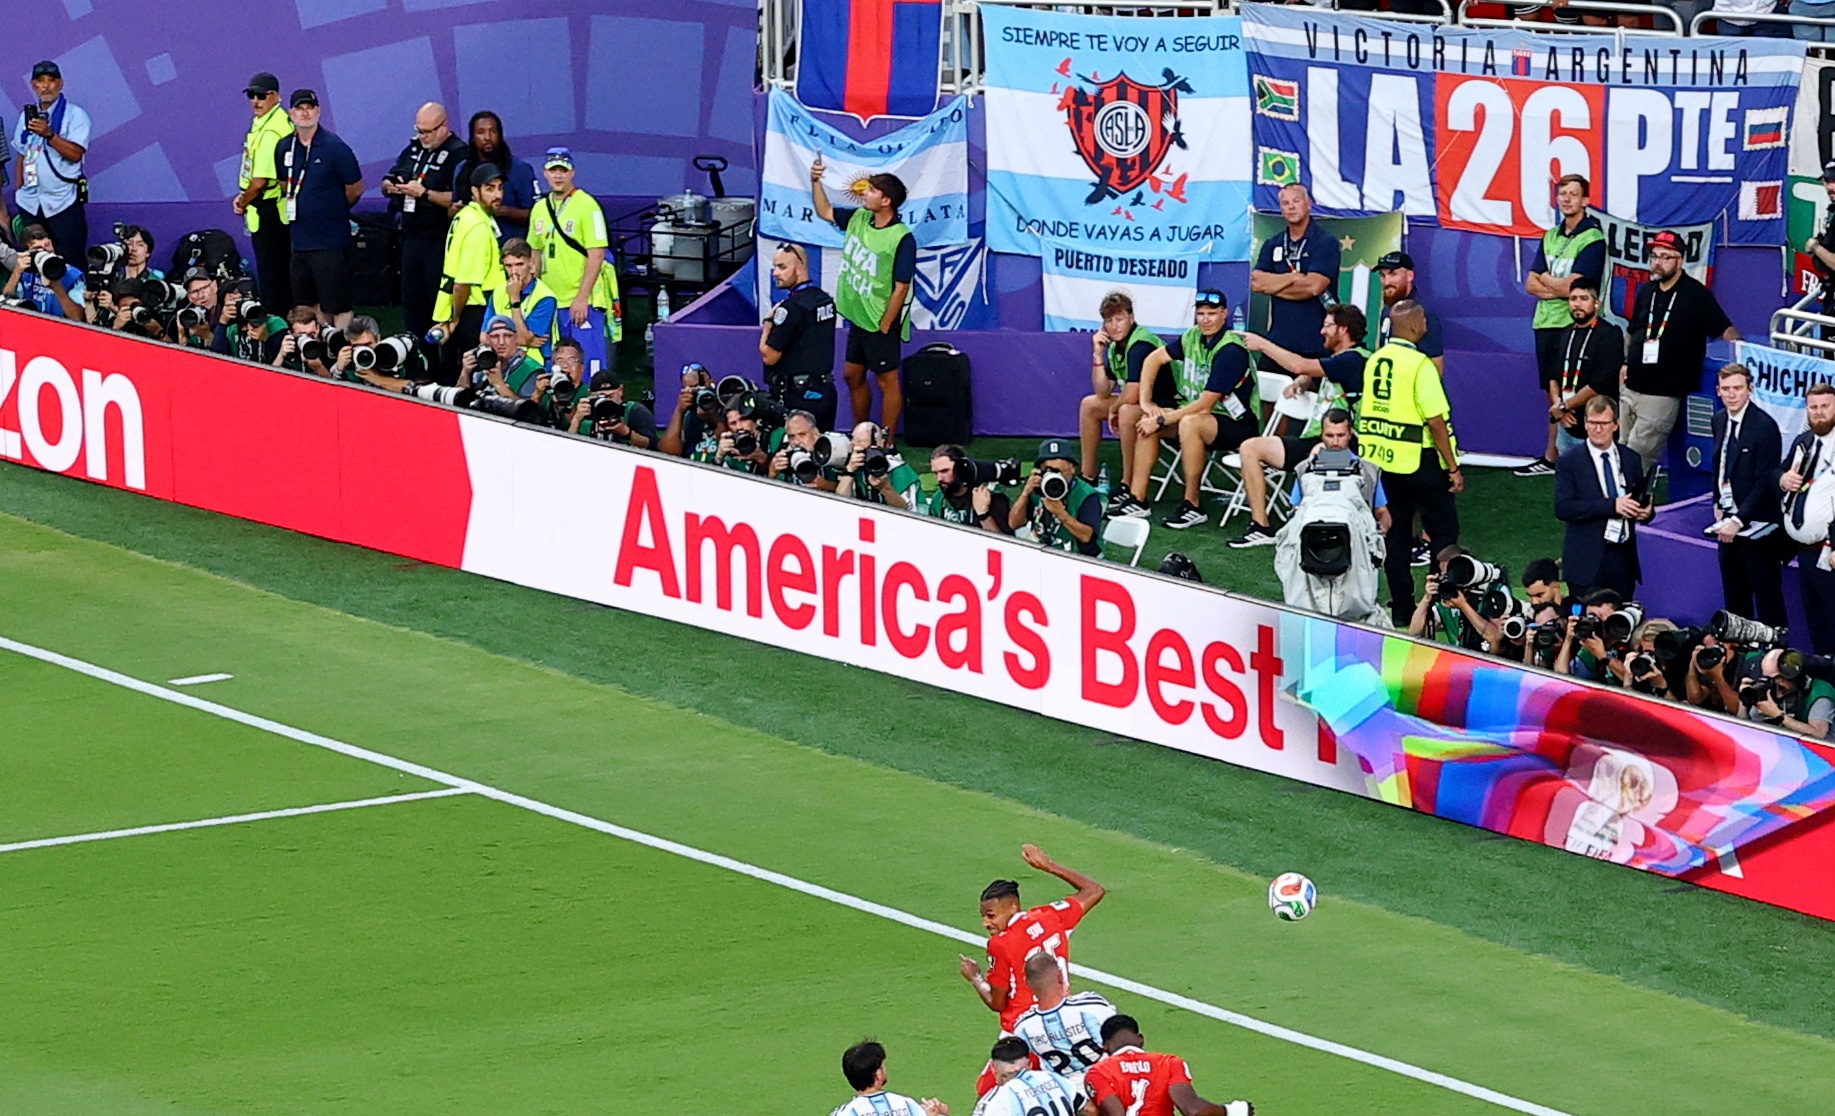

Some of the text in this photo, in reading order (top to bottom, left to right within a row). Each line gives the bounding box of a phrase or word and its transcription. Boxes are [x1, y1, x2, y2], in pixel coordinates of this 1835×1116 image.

[1002, 26, 1240, 53] SIEMPRE TE VOY A SEGUIR
[1303, 21, 1748, 86] VICTORIA ARGENTINA
[1306, 66, 1436, 216] LA
[1447, 79, 1592, 232] 26
[1016, 215, 1225, 242] DONDE VAYAS A JUGAR
[1054, 248, 1188, 280] PUERTO DESEADO
[613, 465, 1285, 751] America's Best
